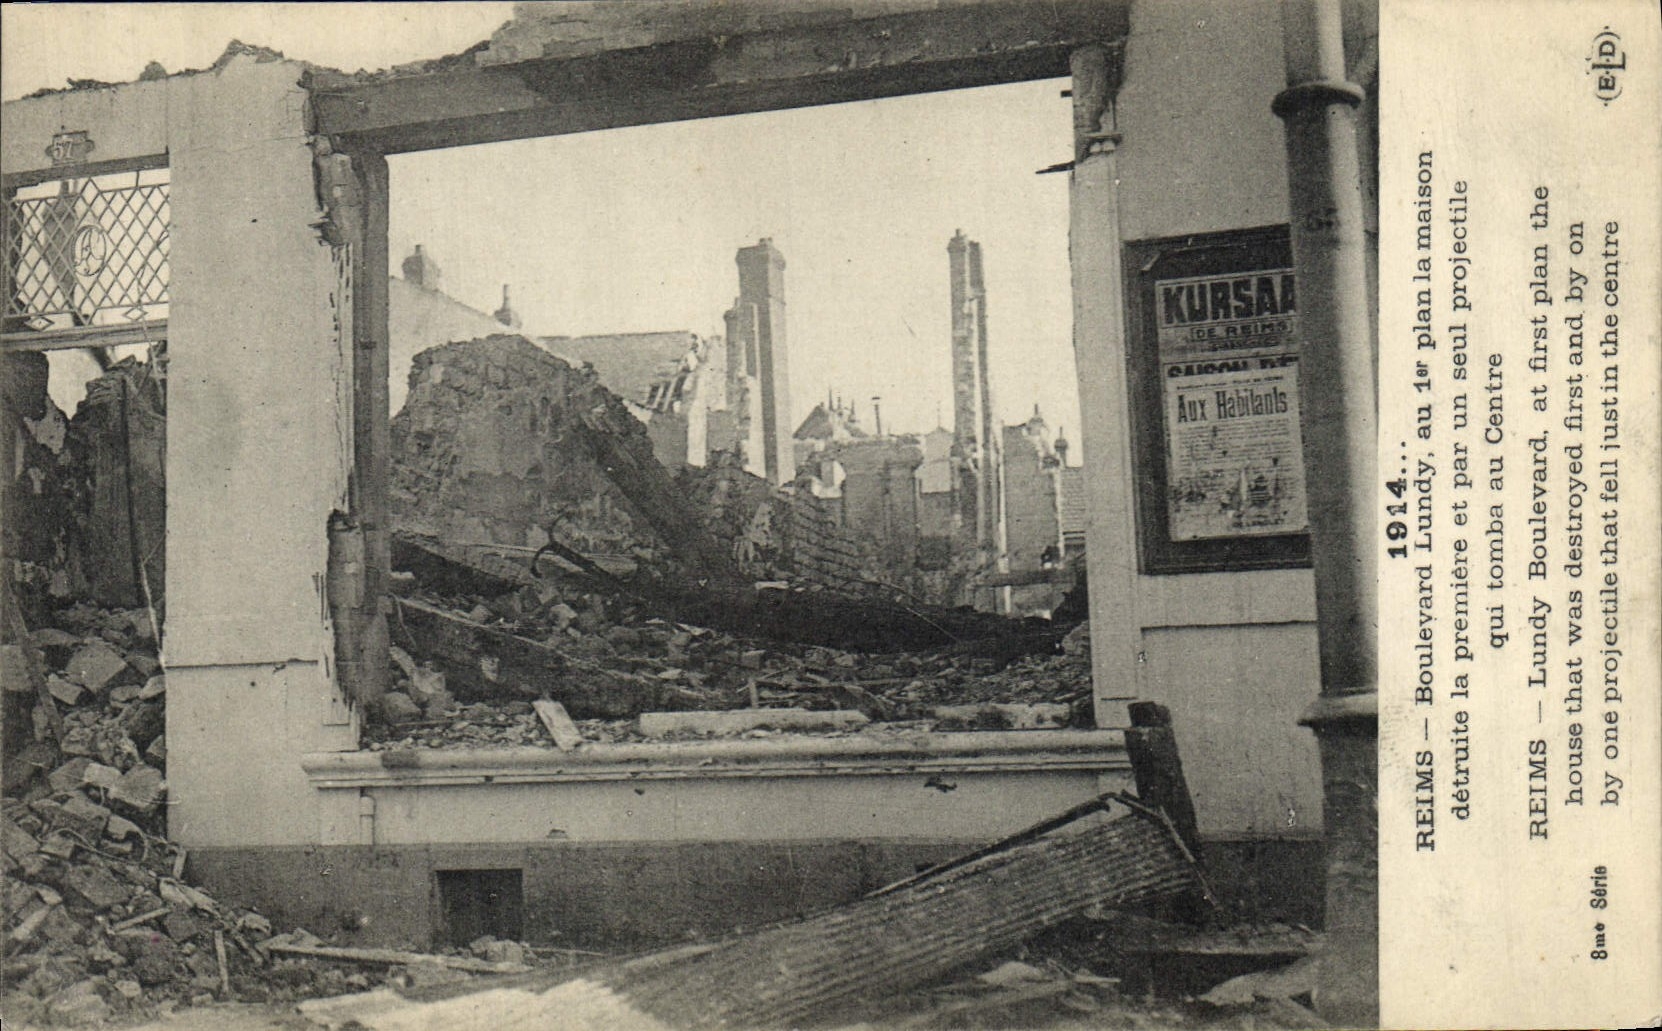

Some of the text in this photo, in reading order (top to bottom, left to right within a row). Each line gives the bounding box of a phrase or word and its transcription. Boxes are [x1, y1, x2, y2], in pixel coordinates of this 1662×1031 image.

[53, 138, 73, 160] 57
[1196, 319, 1288, 340] DE REIMS
[1177, 386, 1289, 423] Aux Habitants
